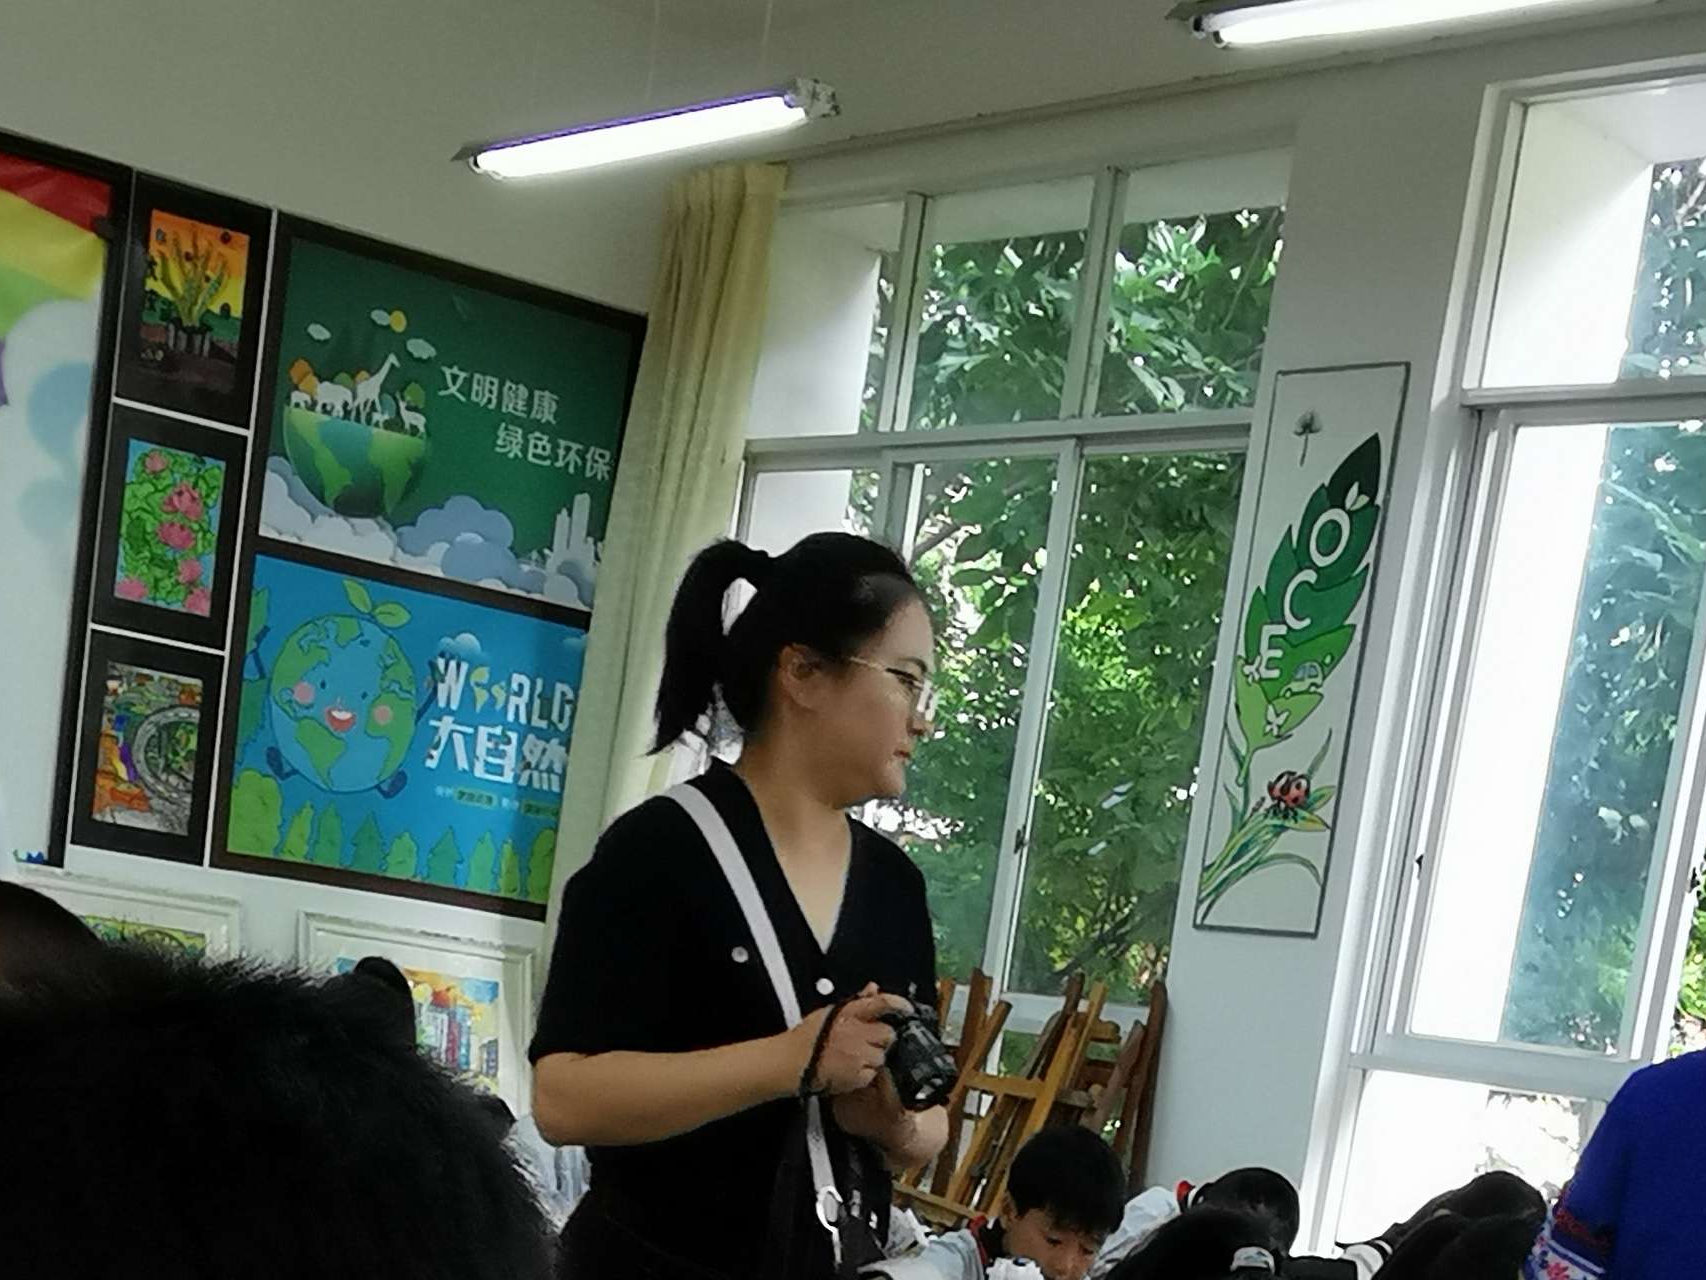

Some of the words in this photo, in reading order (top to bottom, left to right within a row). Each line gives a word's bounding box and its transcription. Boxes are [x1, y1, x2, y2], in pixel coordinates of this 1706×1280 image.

[437, 365, 560, 425] 文明健康
[494, 422, 613, 481] 绿色环保
[424, 714, 569, 793] 大自然
